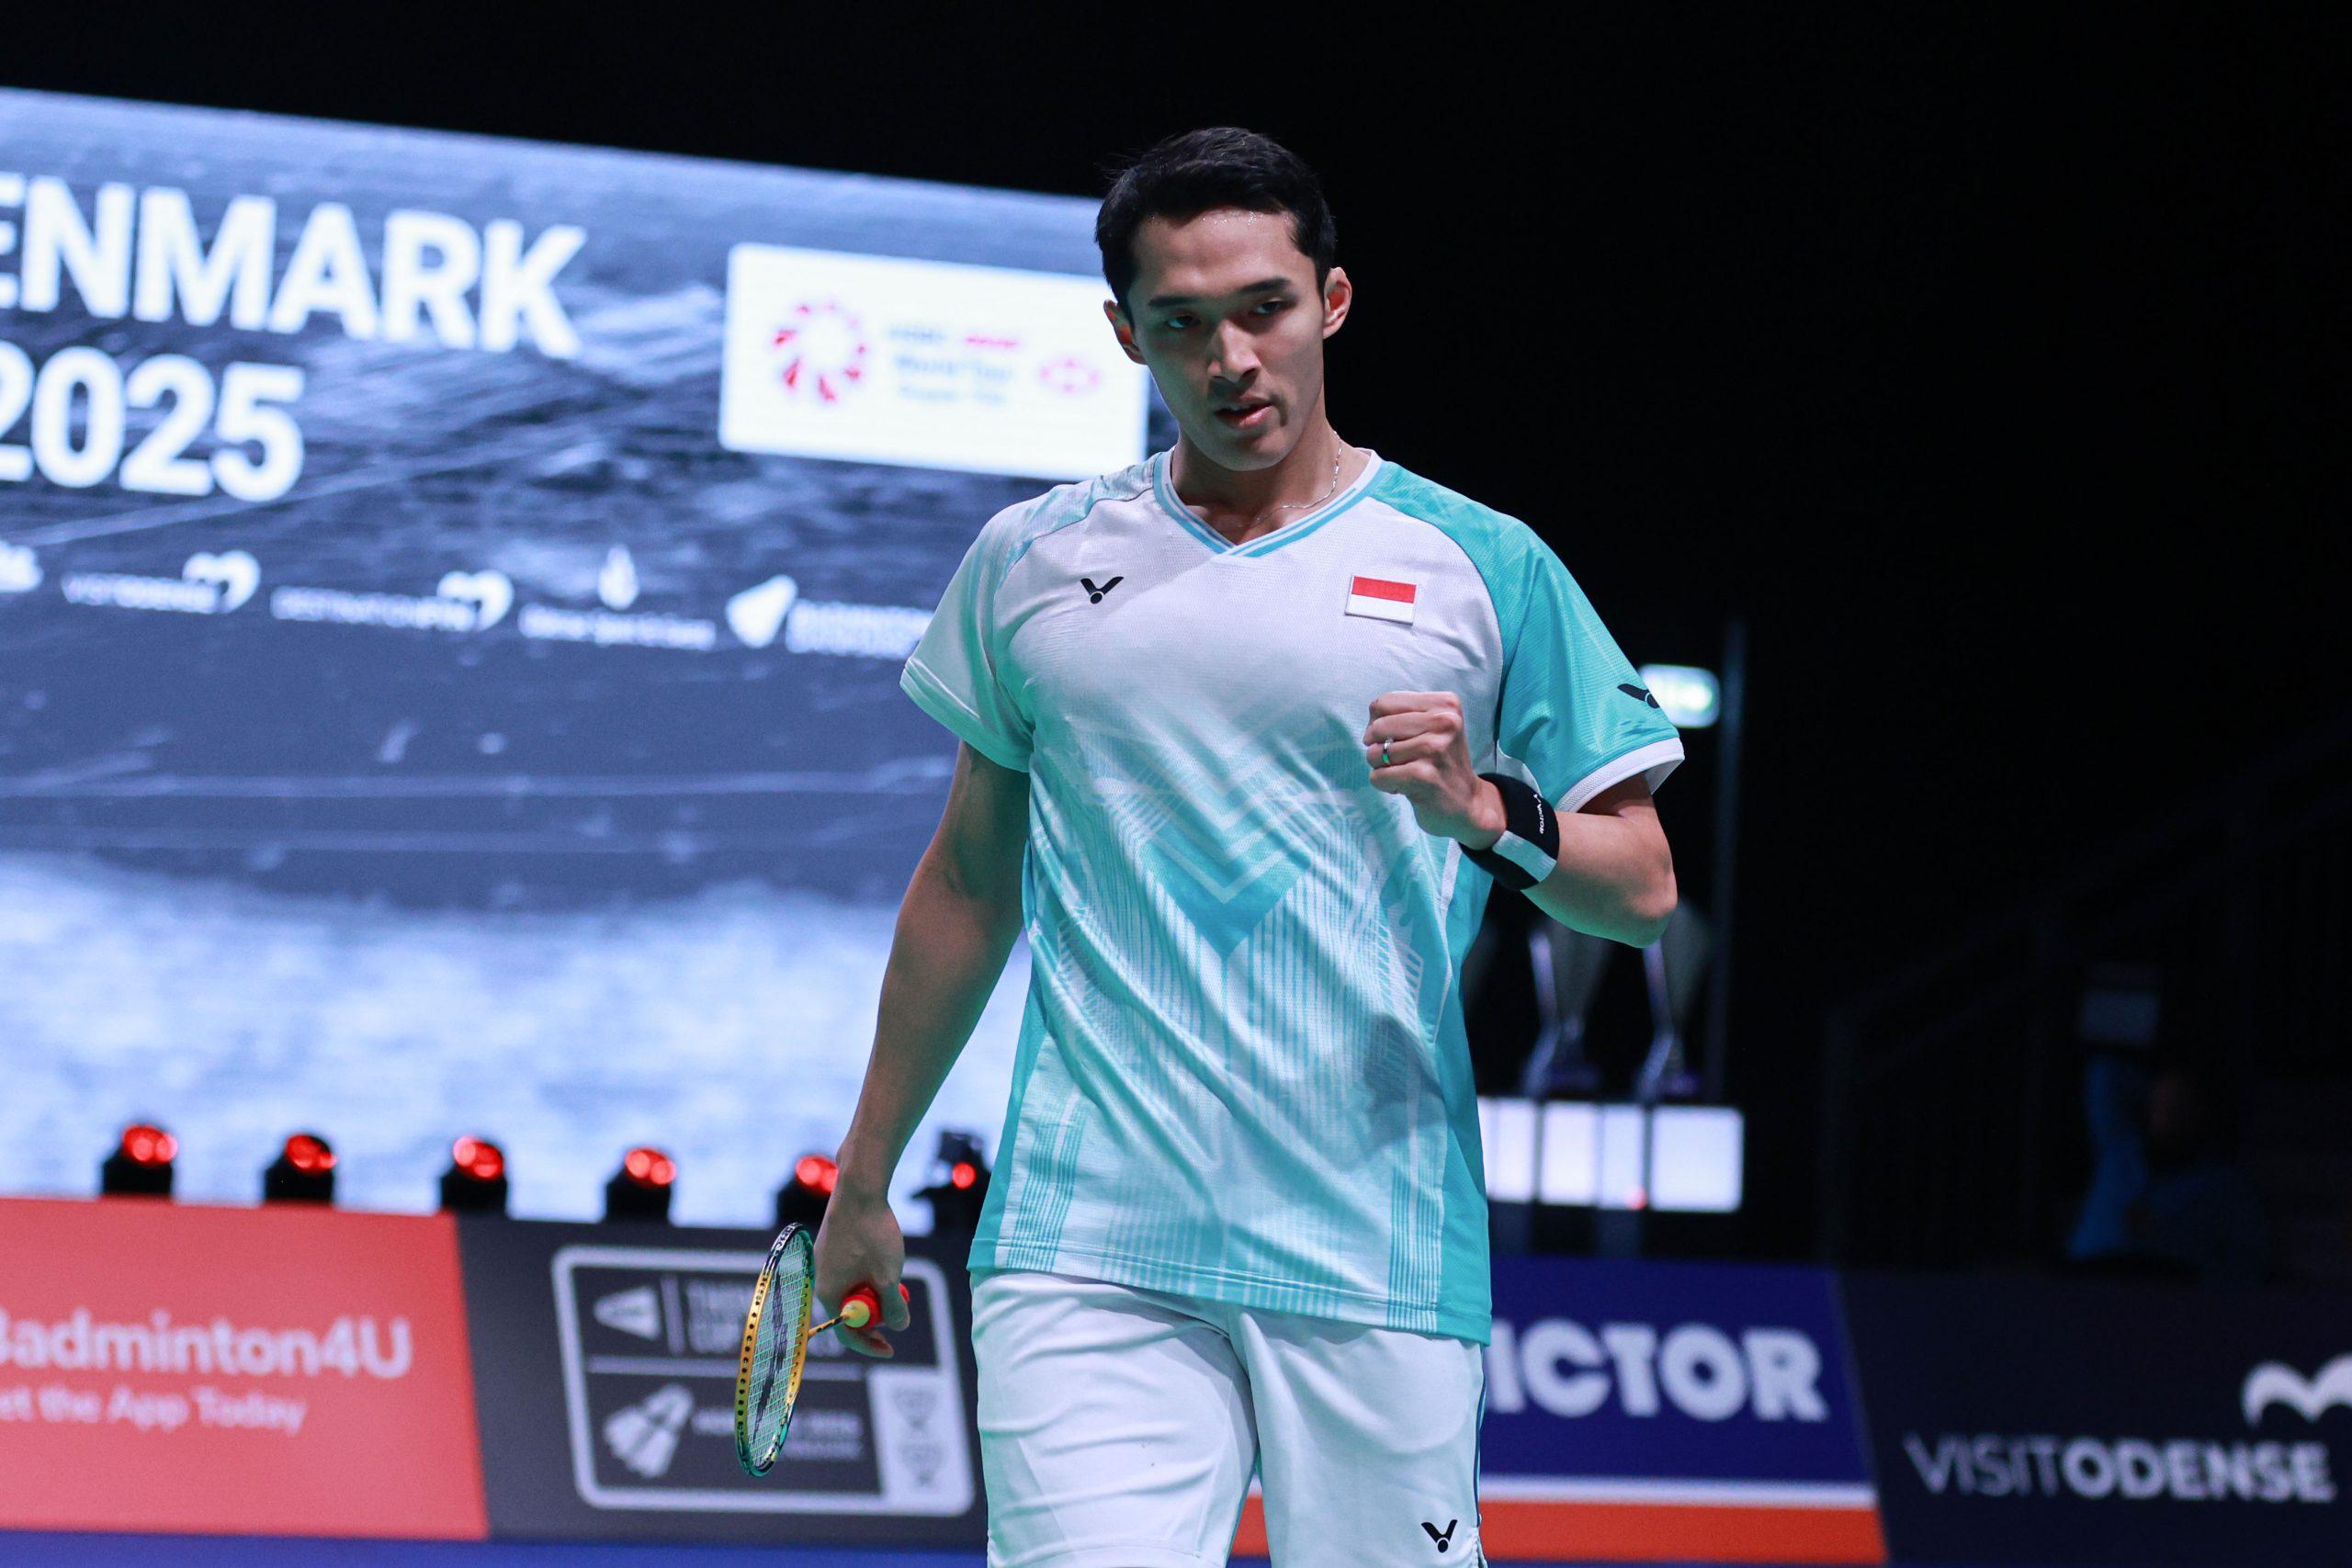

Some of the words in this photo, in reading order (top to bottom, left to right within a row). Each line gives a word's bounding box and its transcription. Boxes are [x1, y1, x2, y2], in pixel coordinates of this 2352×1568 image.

[0, 1305, 413, 1379] adminton4U
[107, 1385, 189, 1432] App
[191, 1384, 307, 1436] Today
[1903, 1431, 2335, 1503] VISITODENSE
